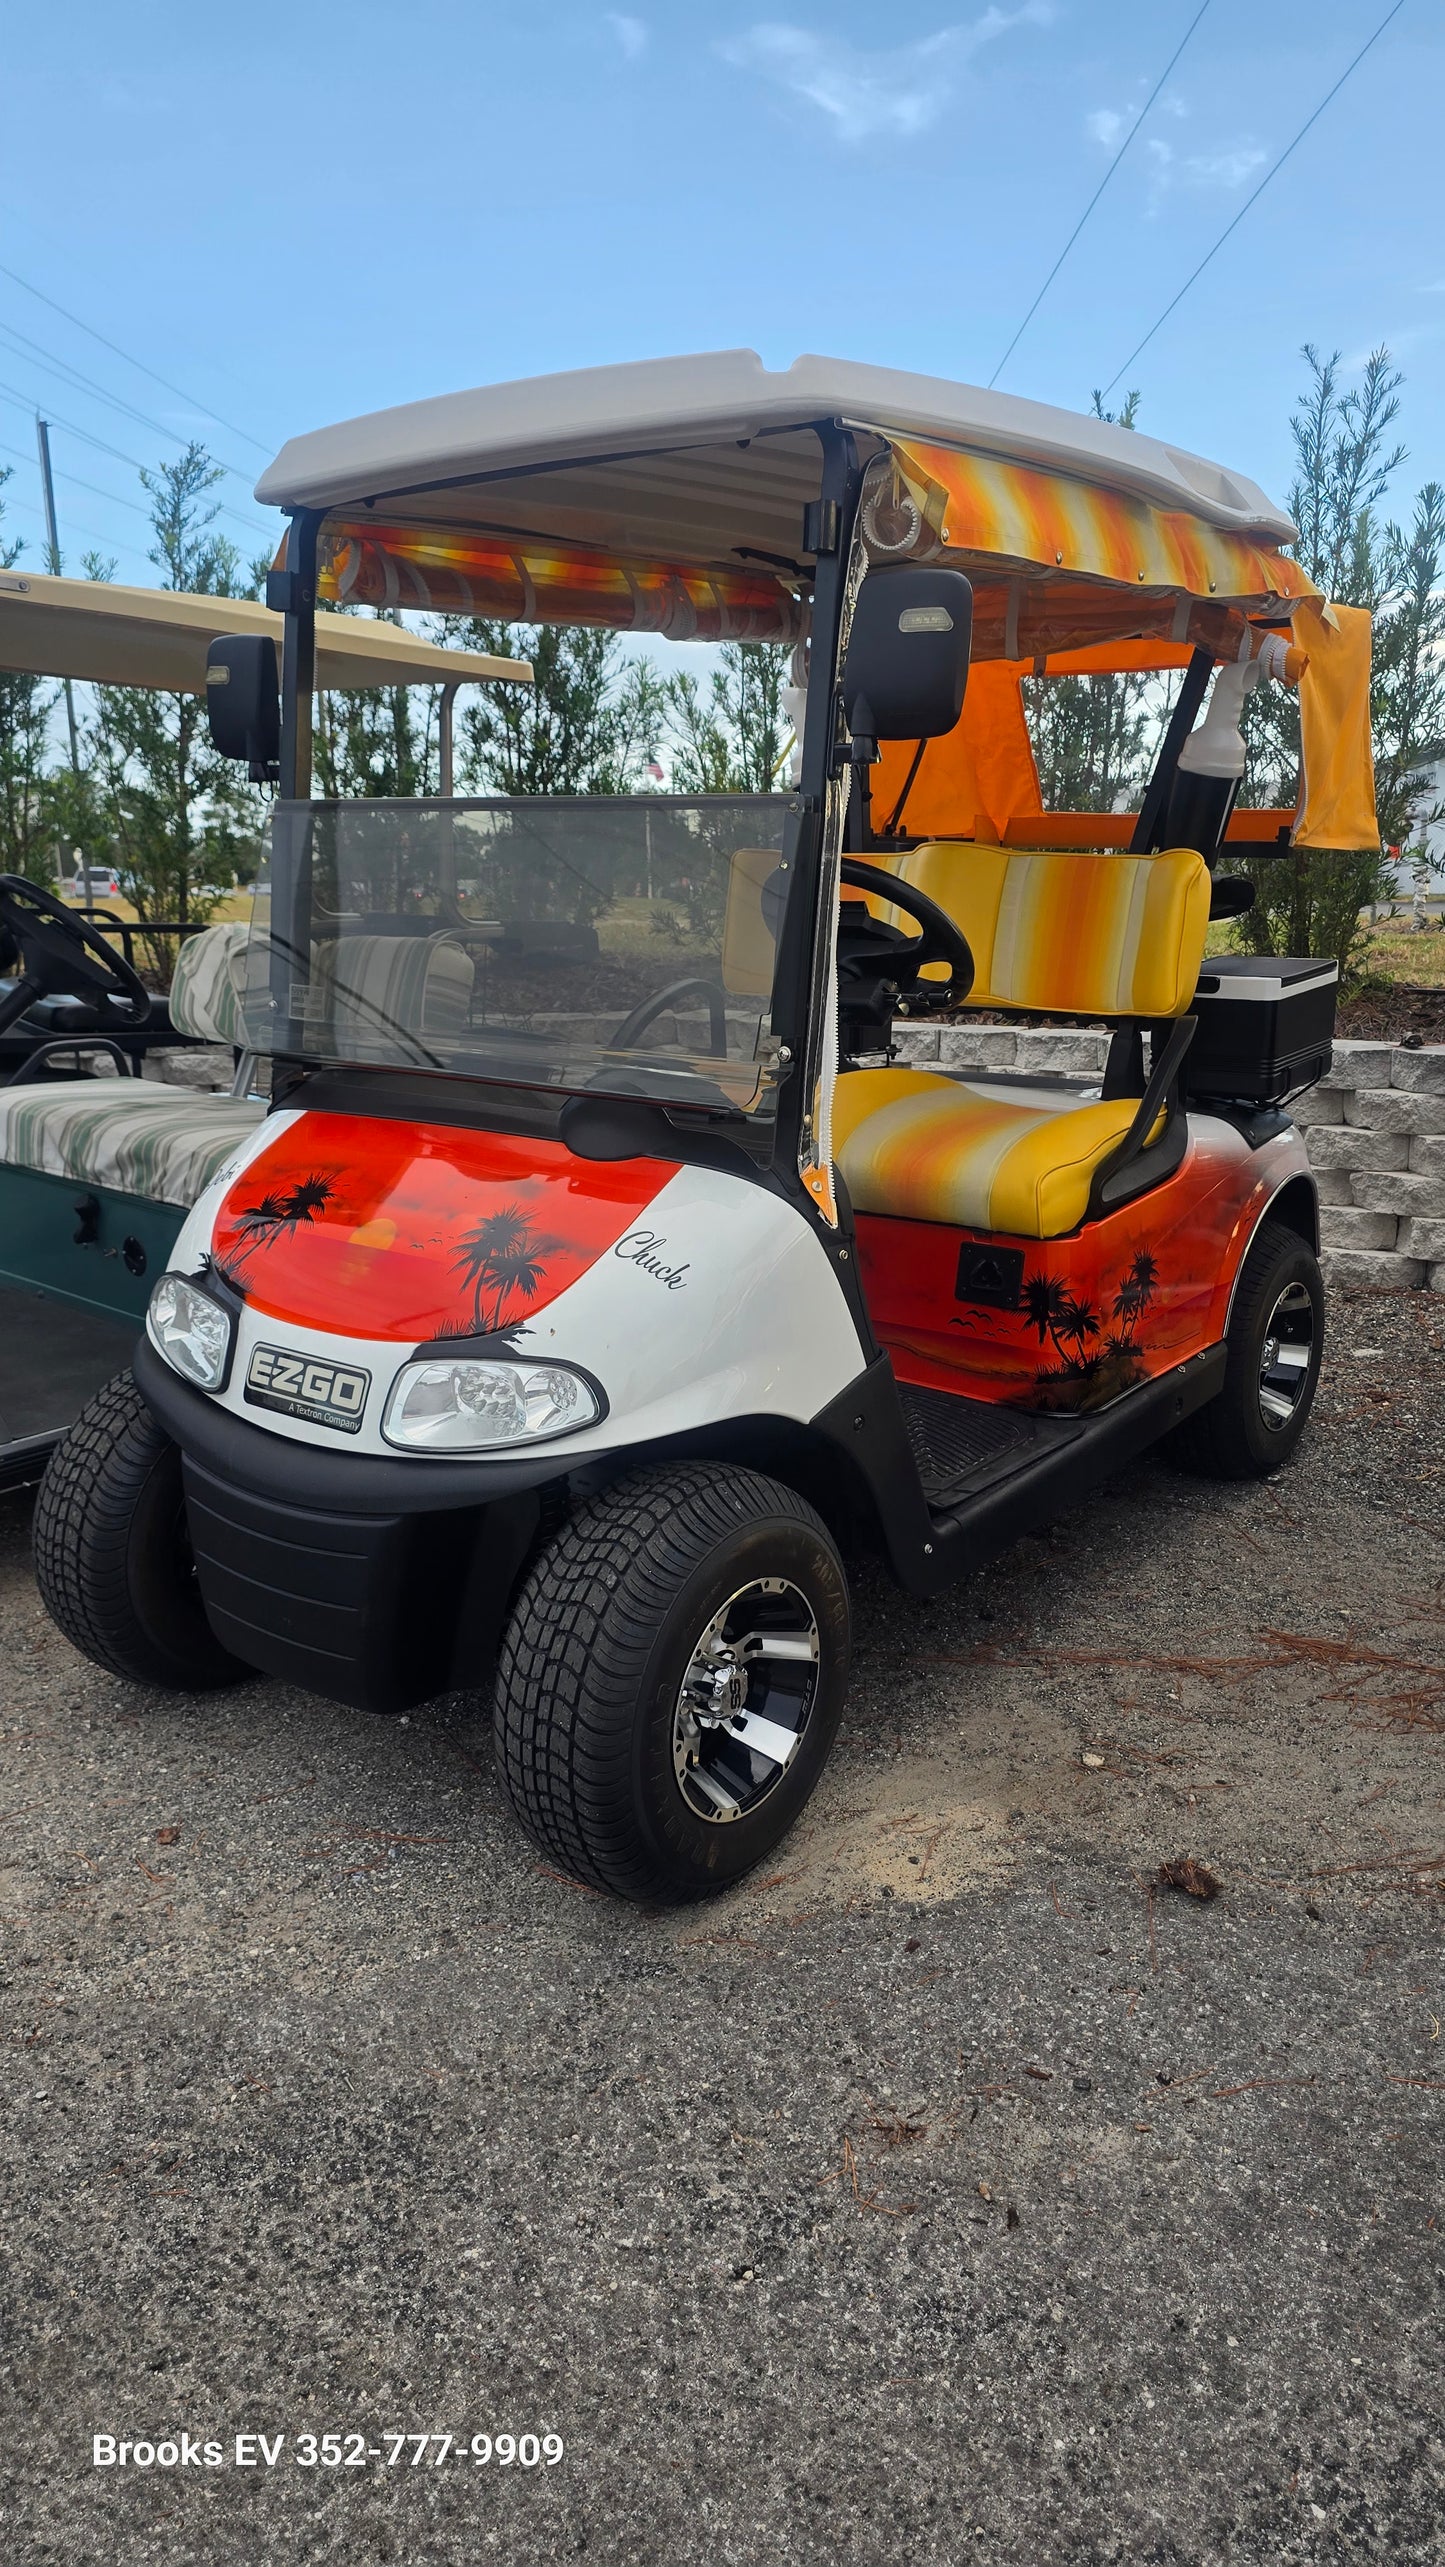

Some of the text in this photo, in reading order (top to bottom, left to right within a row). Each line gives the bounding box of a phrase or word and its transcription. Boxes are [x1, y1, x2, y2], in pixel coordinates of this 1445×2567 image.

[614, 1230, 691, 1290] Chuck
[288, 1402, 361, 1432] A Textron Company
